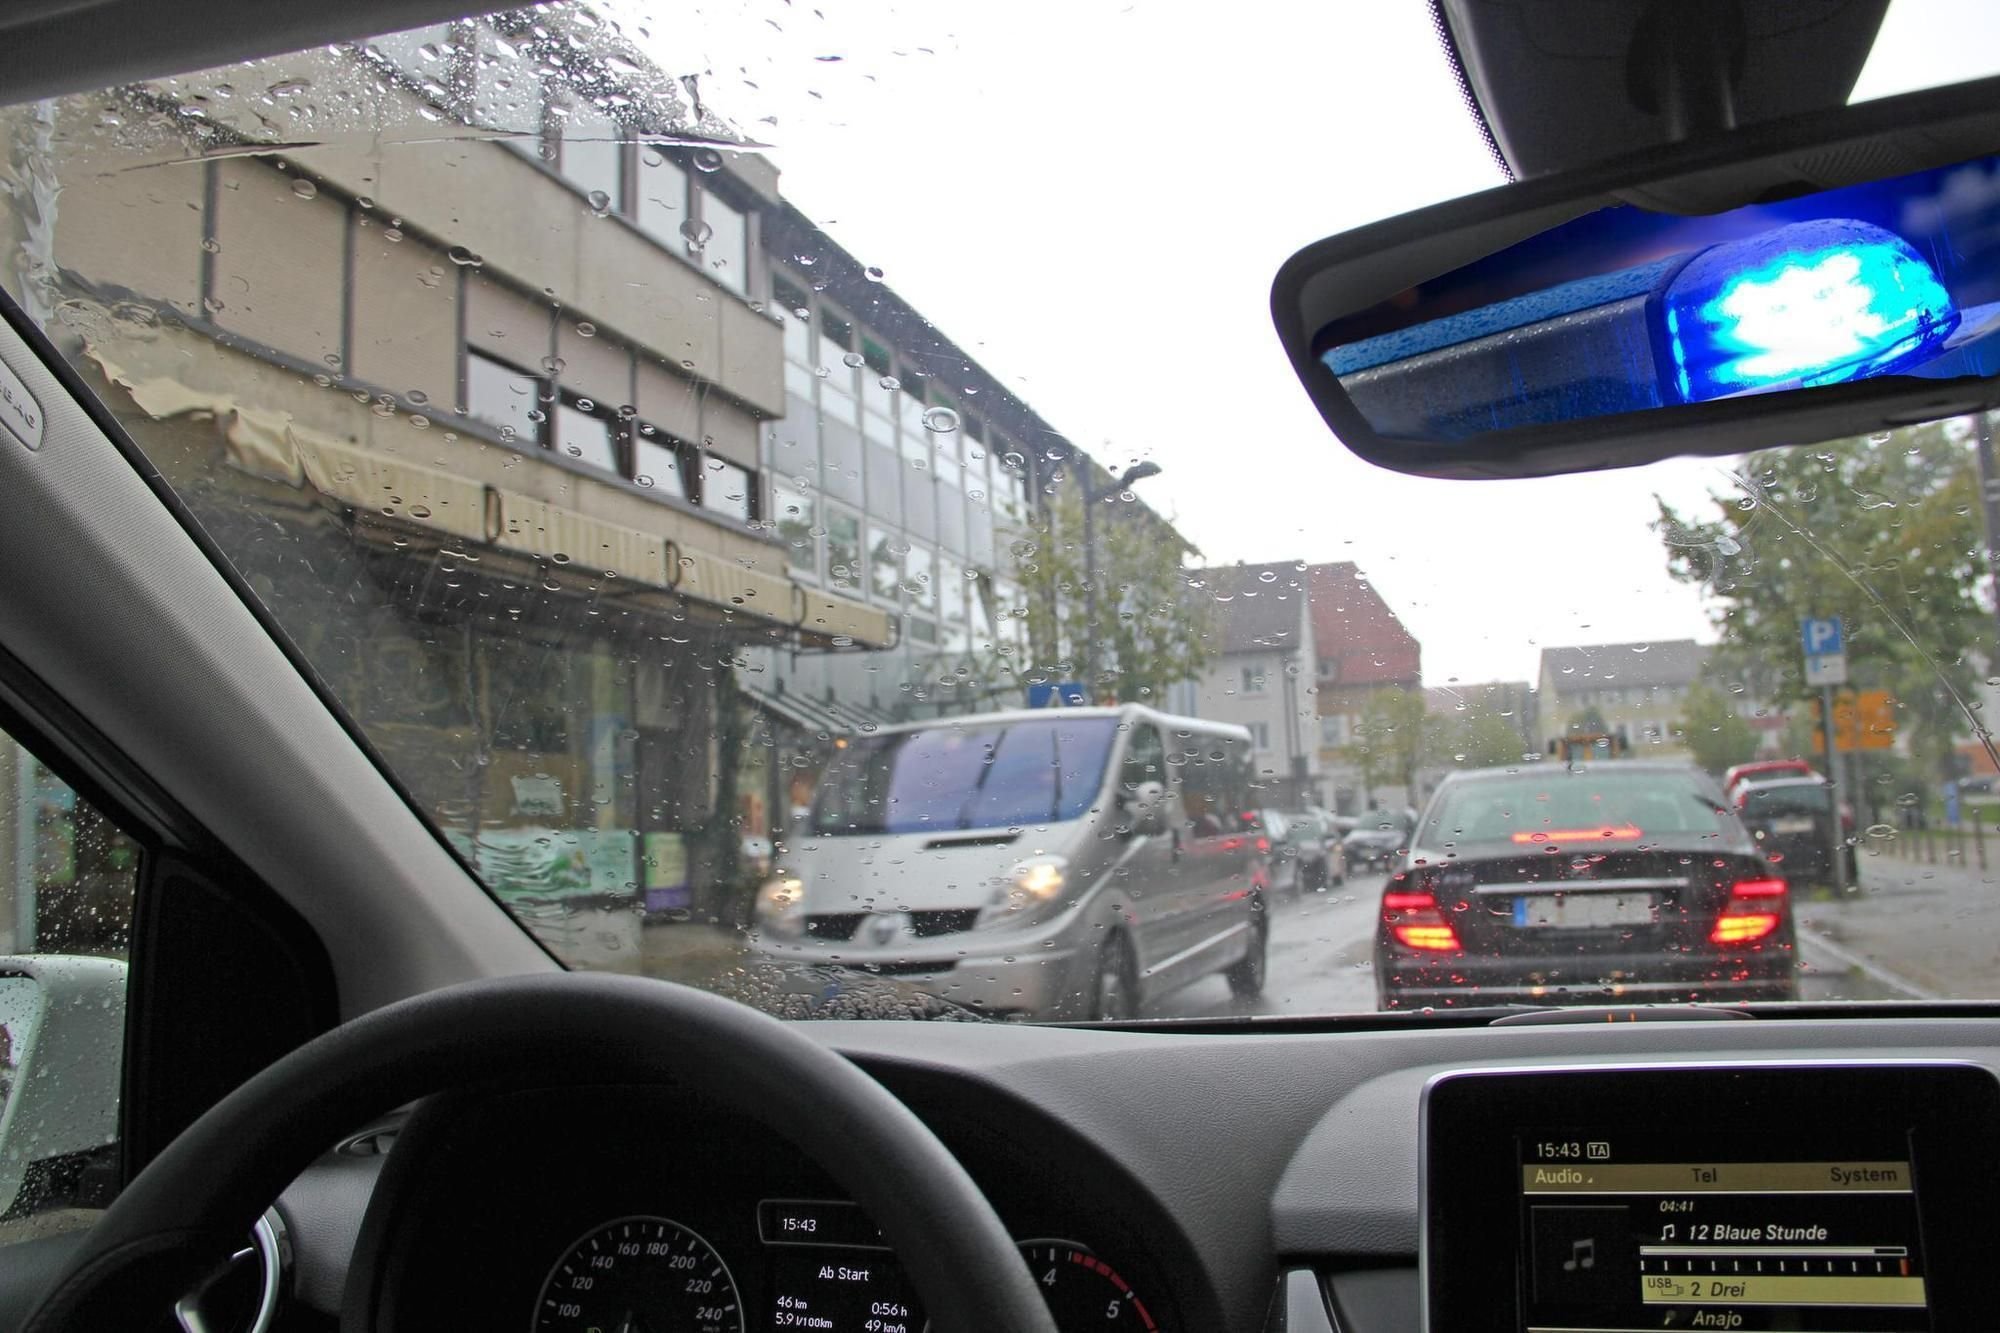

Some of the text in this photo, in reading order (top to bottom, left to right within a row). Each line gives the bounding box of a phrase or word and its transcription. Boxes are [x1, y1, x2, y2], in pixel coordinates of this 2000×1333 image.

[1810, 620, 1835, 651] P
[1537, 1142, 1607, 1158] 15:43 TA
[1535, 1168, 1583, 1184] Audio
[1692, 1167, 1718, 1183] Tel
[1830, 1166, 1898, 1186] System
[1659, 1200, 1695, 1213] 04:41
[782, 1218, 817, 1232] 15:43
[1689, 1224, 1828, 1241] 12 Blaue Stunde
[617, 1243, 640, 1256] 160
[646, 1242, 669, 1256] 180
[591, 1255, 614, 1269] 140
[669, 1255, 696, 1270] 200
[818, 1265, 870, 1282] Ab Start
[1042, 1268, 1057, 1287] 4
[572, 1276, 594, 1290] 120
[685, 1279, 712, 1294] 220
[1647, 1277, 1673, 1289] USB
[1690, 1281, 1747, 1298] 2 Drei
[777, 1295, 808, 1310] 46 km
[870, 1302, 908, 1317] 0:56 h
[1106, 1300, 1121, 1320] 5
[558, 1303, 581, 1318] 100
[695, 1306, 723, 1321] 240
[775, 1311, 795, 1325] 5.9
[864, 1319, 907, 1333] 49 km/h
[1692, 1309, 1743, 1330] Anajo
